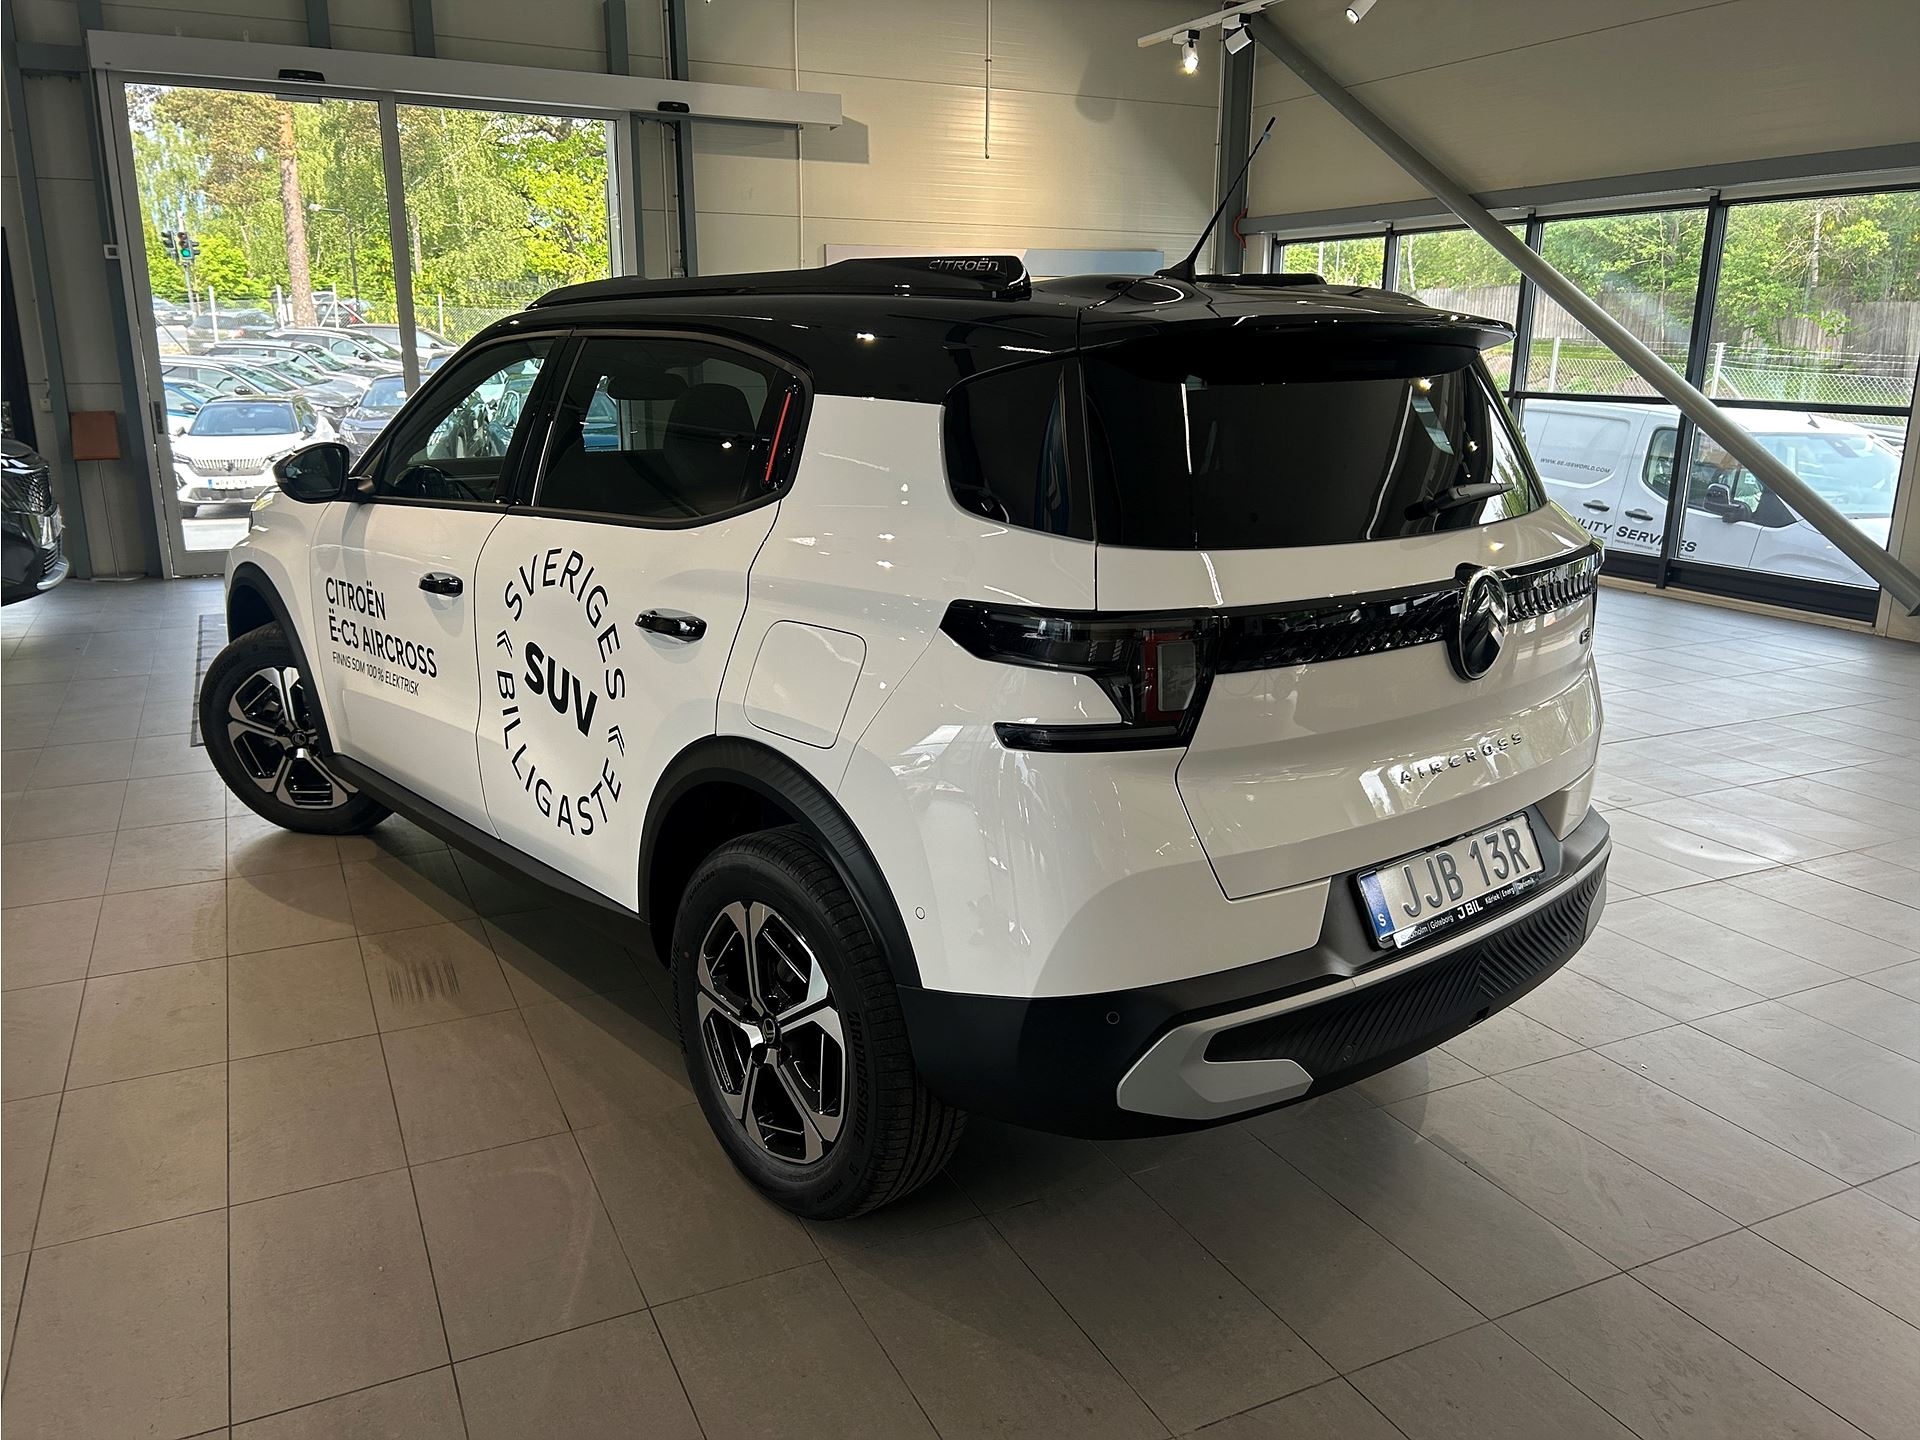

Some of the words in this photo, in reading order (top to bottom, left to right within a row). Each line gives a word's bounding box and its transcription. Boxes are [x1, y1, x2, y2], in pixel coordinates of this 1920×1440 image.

[1578, 518, 1613, 534] LITY
[1616, 526, 1698, 552] SERVIES
[325, 576, 387, 621] CITROËN
[504, 547, 626, 701] SVERIGES
[328, 607, 359, 650] Ë-C3
[362, 626, 438, 679] AIRCROSS
[333, 651, 352, 669] FINNS
[352, 658, 366, 674] SOM
[385, 671, 420, 697] ELEKTRISK
[524, 641, 598, 738] SUV
[496, 669, 622, 836] BILLIGASTE
[1400, 731, 1522, 785] AIRCROSS
[1402, 851, 1464, 918] JJB
[1468, 827, 1531, 887] 13R
[1377, 913, 1387, 927] S
[1430, 913, 1455, 930] Göteborg
